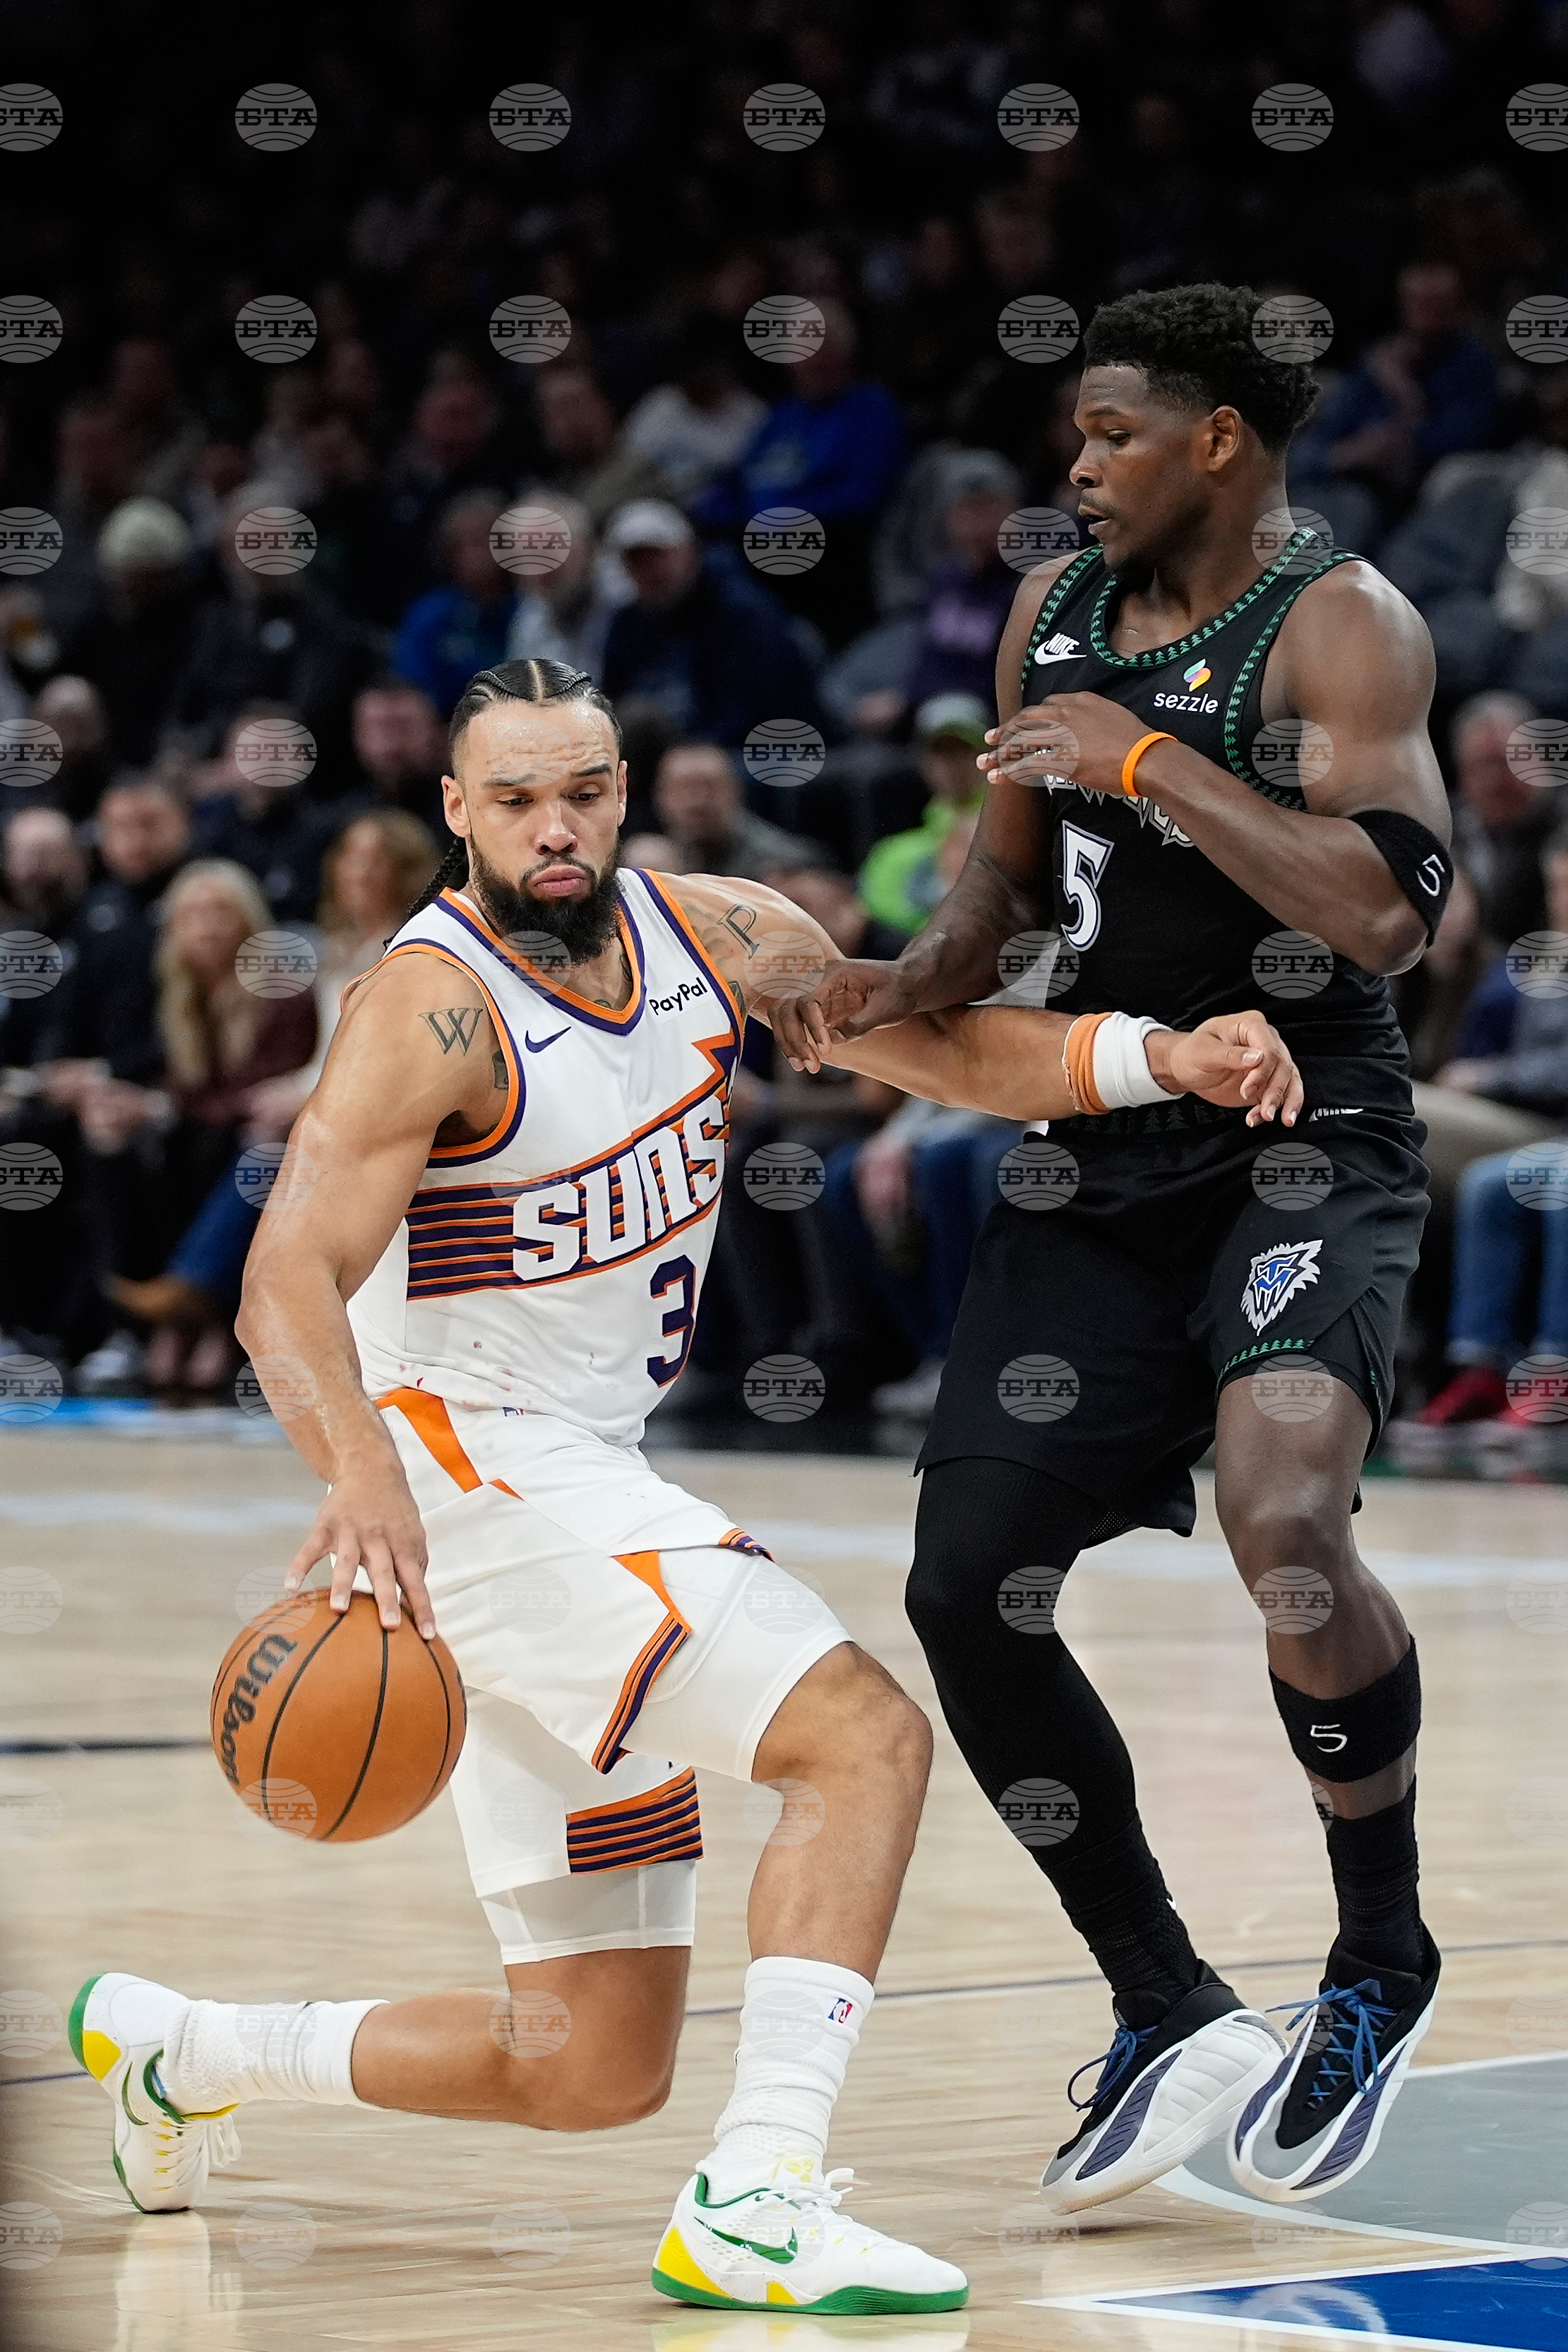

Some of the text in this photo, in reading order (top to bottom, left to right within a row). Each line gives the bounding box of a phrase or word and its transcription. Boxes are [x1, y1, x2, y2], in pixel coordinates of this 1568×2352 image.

[1045, 633, 1079, 655] NIKE
[1154, 693, 1219, 714] sezzle
[1060, 819, 1115, 951] 5
[1416, 854, 1446, 897] 5
[717, 903, 760, 960] P
[649, 977, 708, 1016] PayPal
[419, 1008, 483, 1056] W
[647, 1254, 696, 1388] 3
[1310, 1724, 1348, 1753] 5
